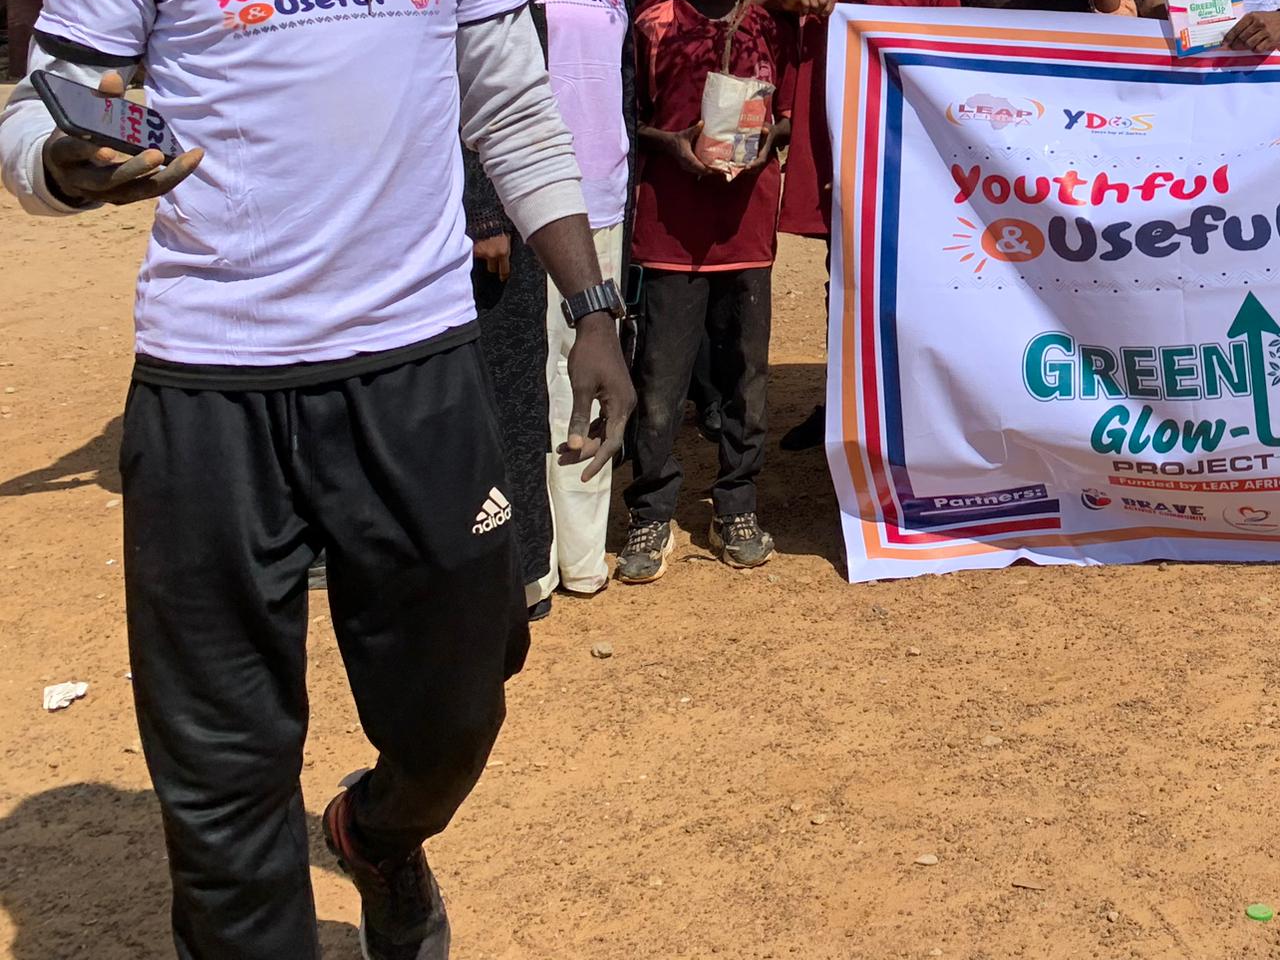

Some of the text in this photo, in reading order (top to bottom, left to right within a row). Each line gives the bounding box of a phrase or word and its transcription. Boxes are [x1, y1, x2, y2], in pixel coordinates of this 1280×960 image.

[958, 103, 1034, 118] LEAP
[950, 163, 1230, 206] Youthful
[995, 226, 1033, 255] &
[1022, 330, 1252, 401] GREEN
[1112, 454, 1275, 476] PROJECT
[1118, 478, 1175, 489] Funded
[1179, 481, 1198, 491] by
[1202, 480, 1239, 491] LEAP
[935, 487, 1043, 508] Partners:
